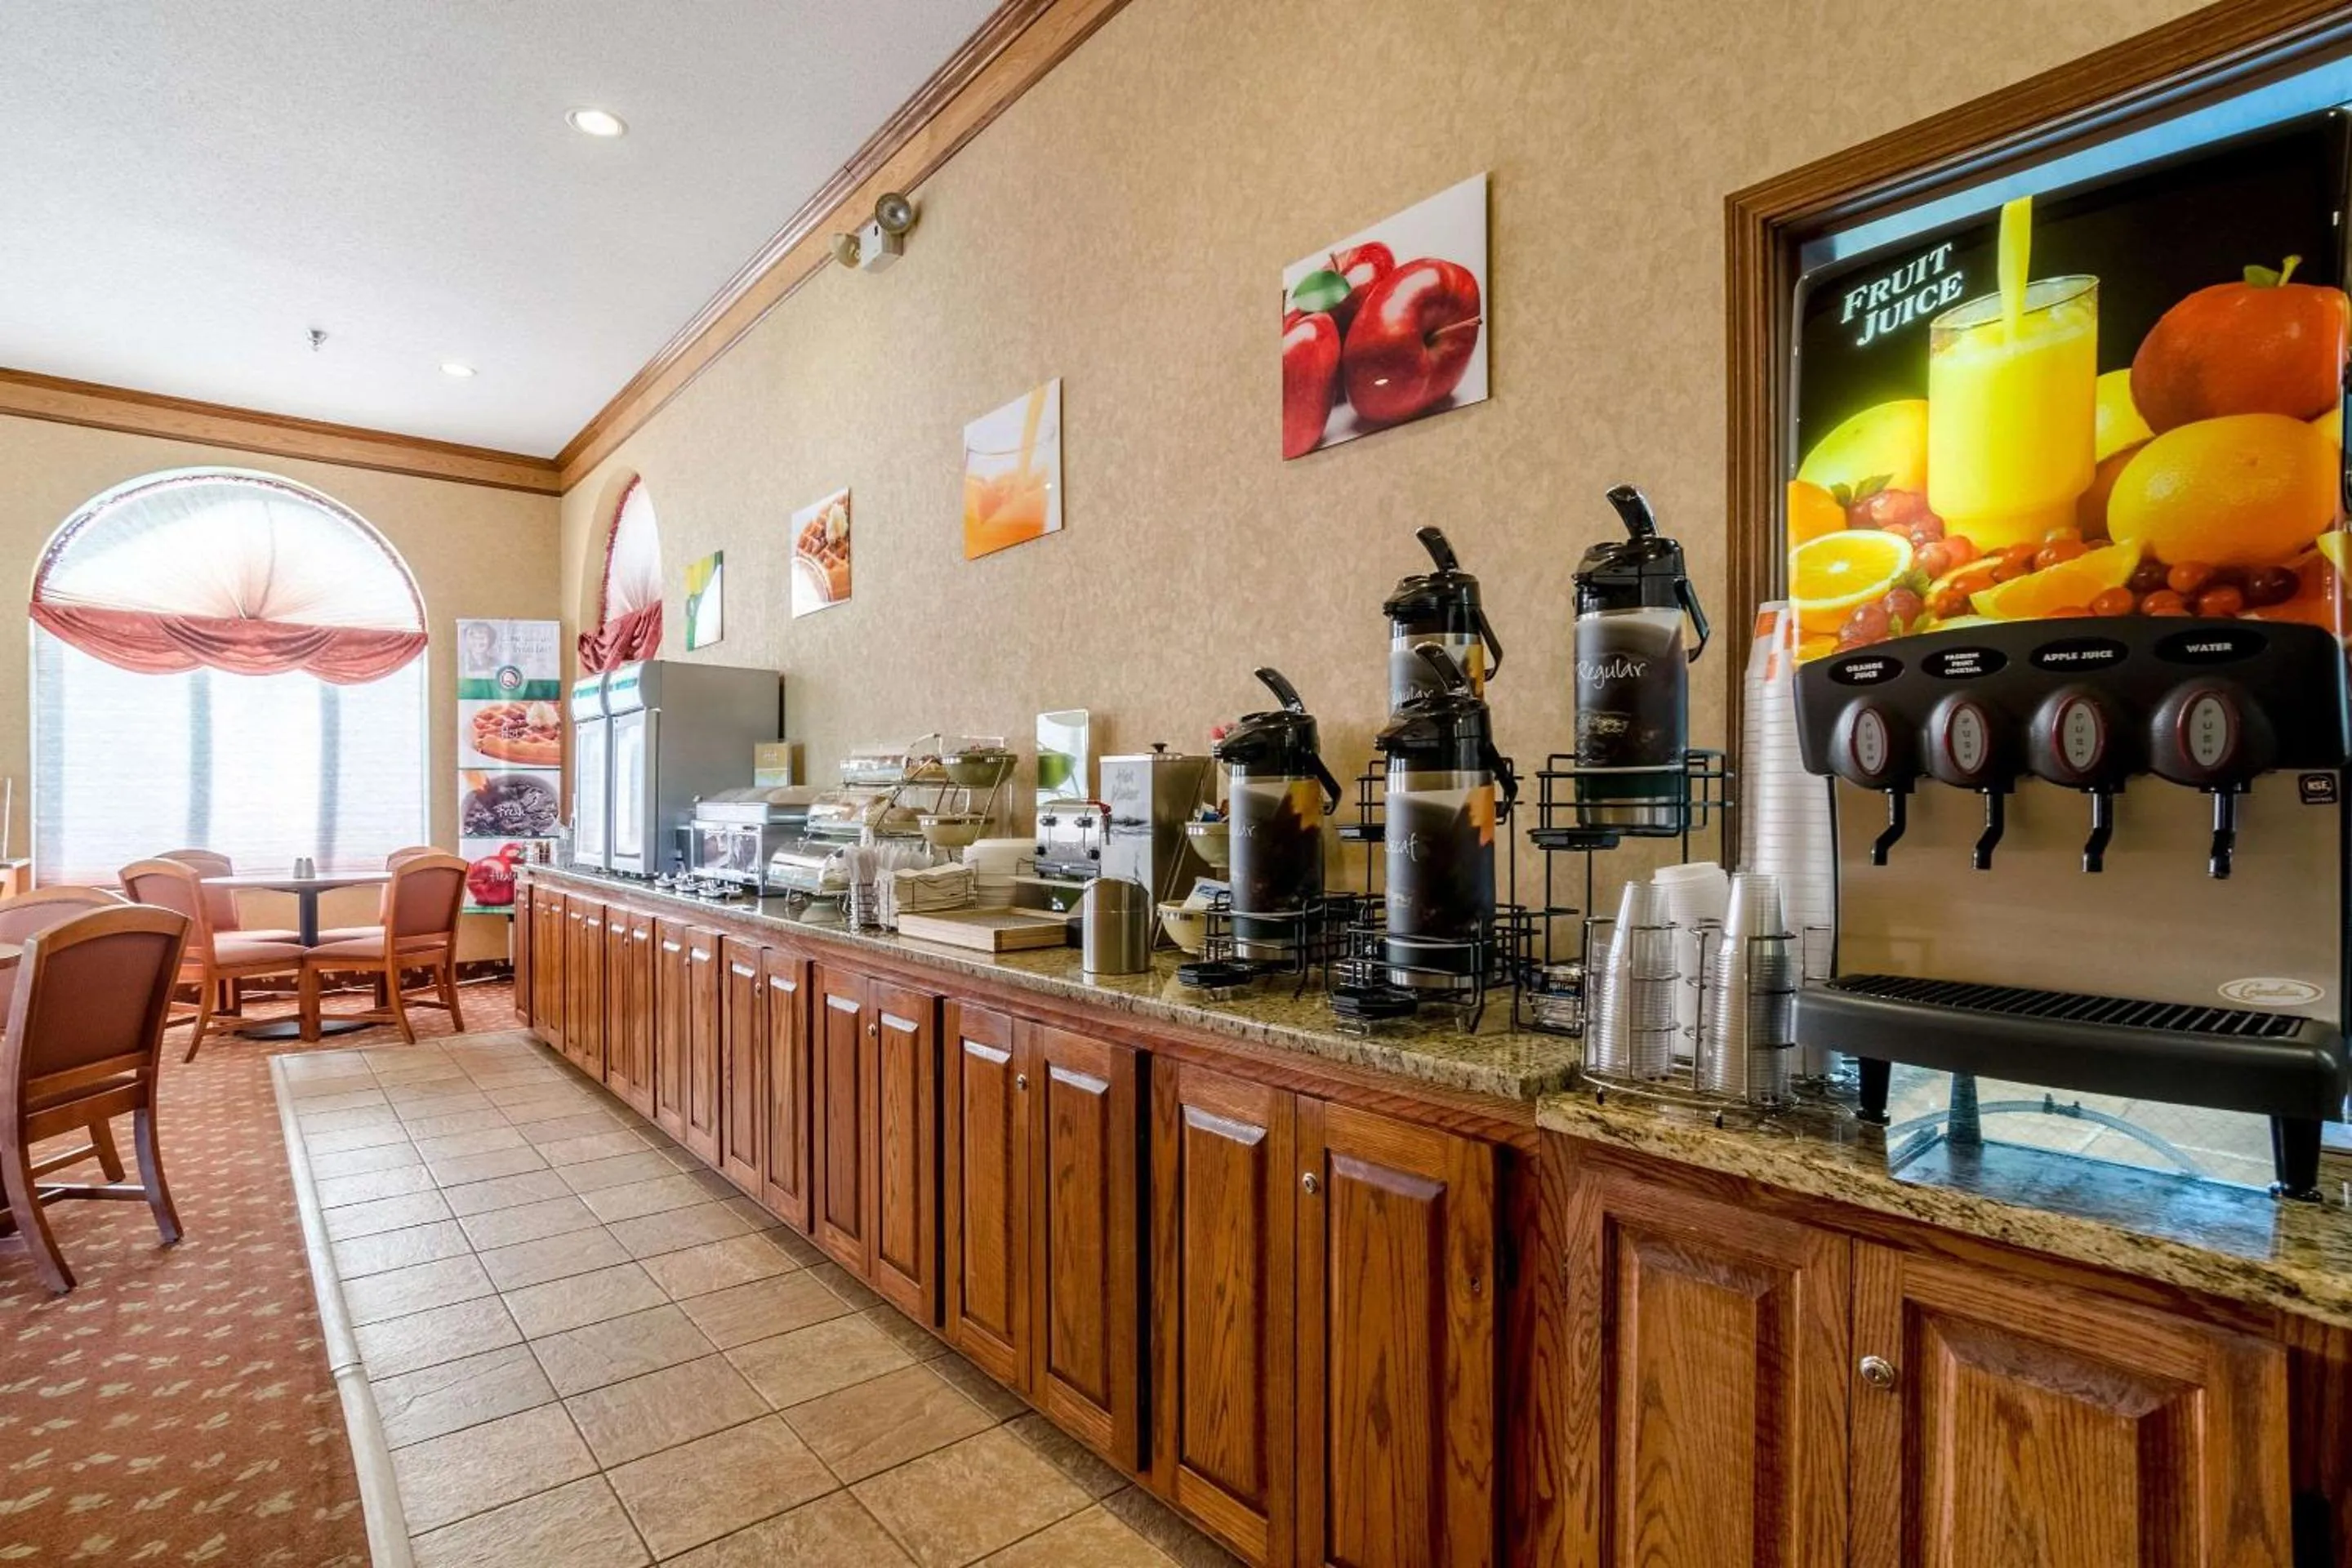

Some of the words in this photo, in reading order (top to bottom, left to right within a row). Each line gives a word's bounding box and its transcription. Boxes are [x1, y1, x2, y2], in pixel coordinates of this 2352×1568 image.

[1841, 242, 1953, 324] FRUIT
[1855, 270, 1964, 346] JUICE
[2185, 642, 2233, 653] WATER
[2042, 652, 2078, 662] APPLE
[2082, 649, 2114, 660] JUICE
[1576, 657, 1648, 689] Regular
[1845, 662, 1884, 673] ORANGE
[1853, 670, 1878, 679] JUICE
